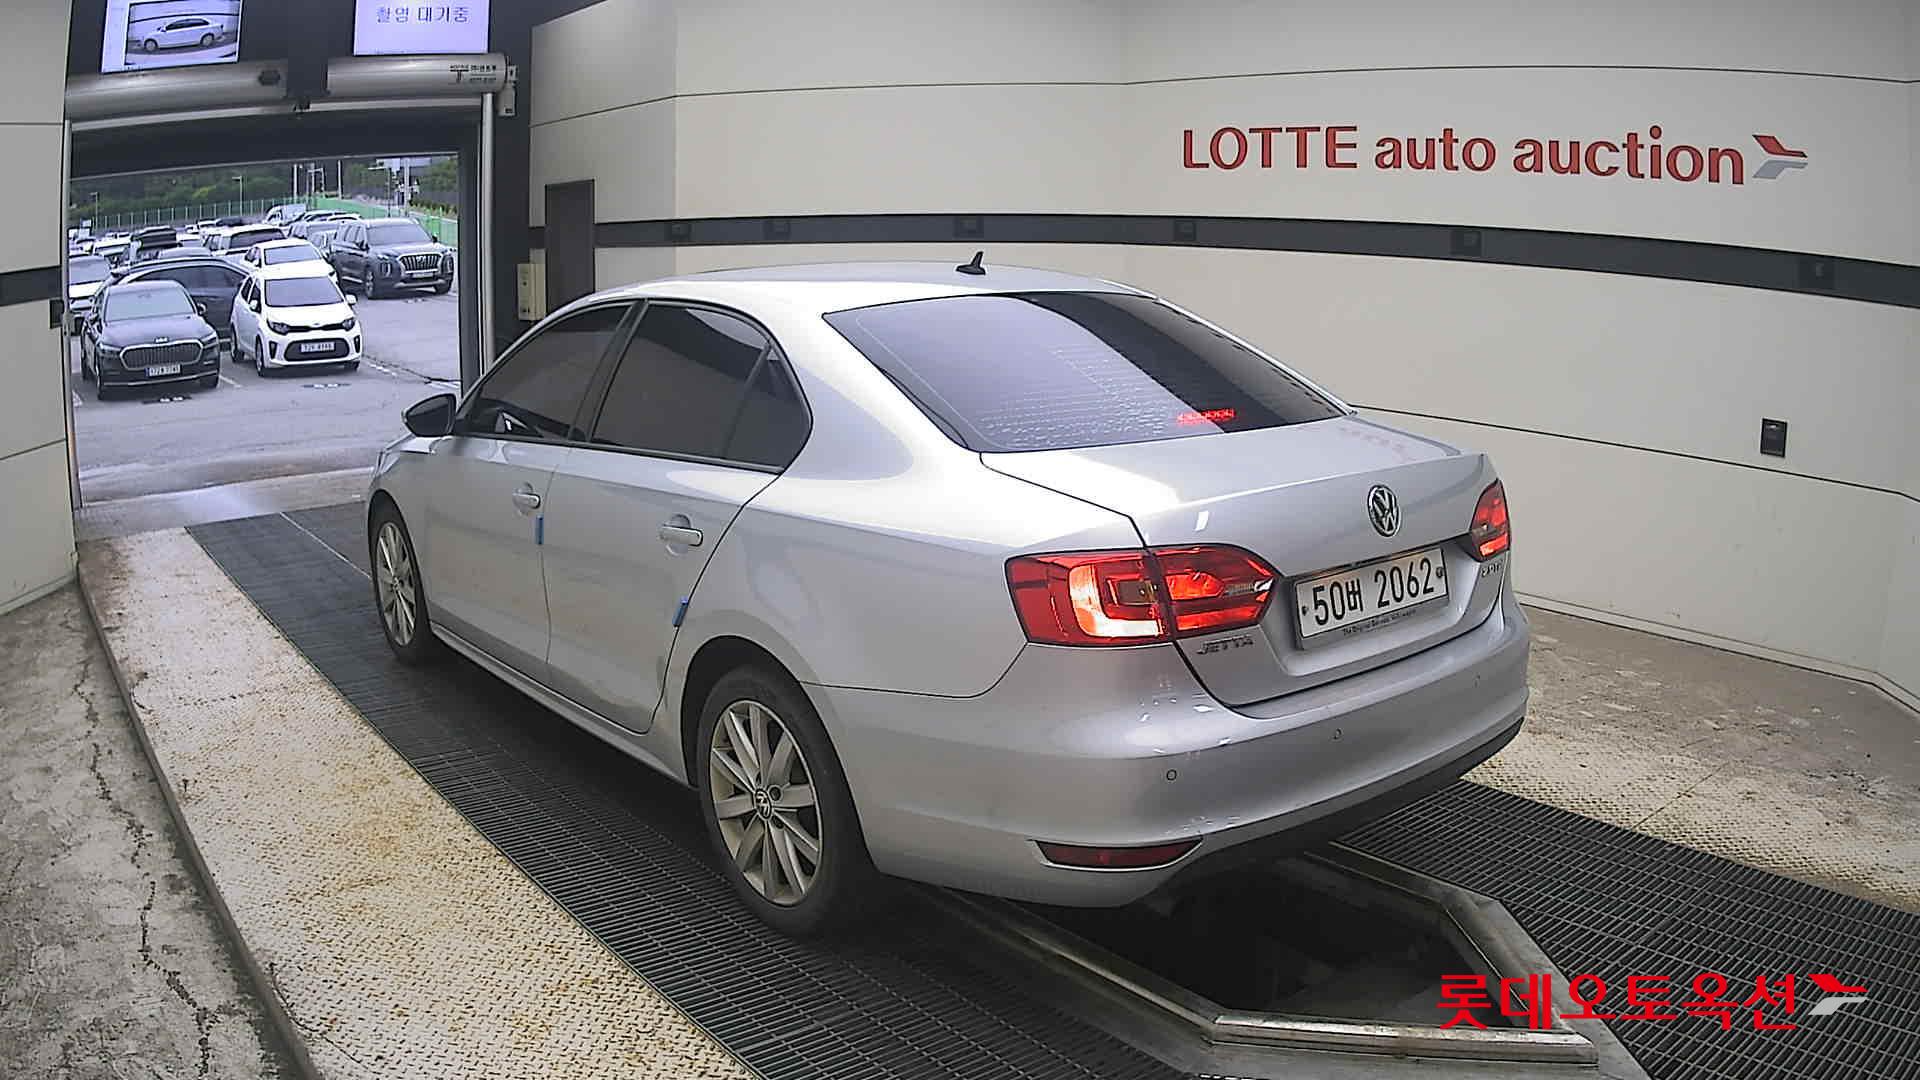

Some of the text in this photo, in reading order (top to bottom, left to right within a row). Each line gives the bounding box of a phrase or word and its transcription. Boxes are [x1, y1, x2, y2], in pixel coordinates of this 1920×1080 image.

[417, 6, 471, 23] 대기중
[1183, 125, 1745, 186] LOTTE auto auction
[1312, 557, 1434, 626] 50버 2062
